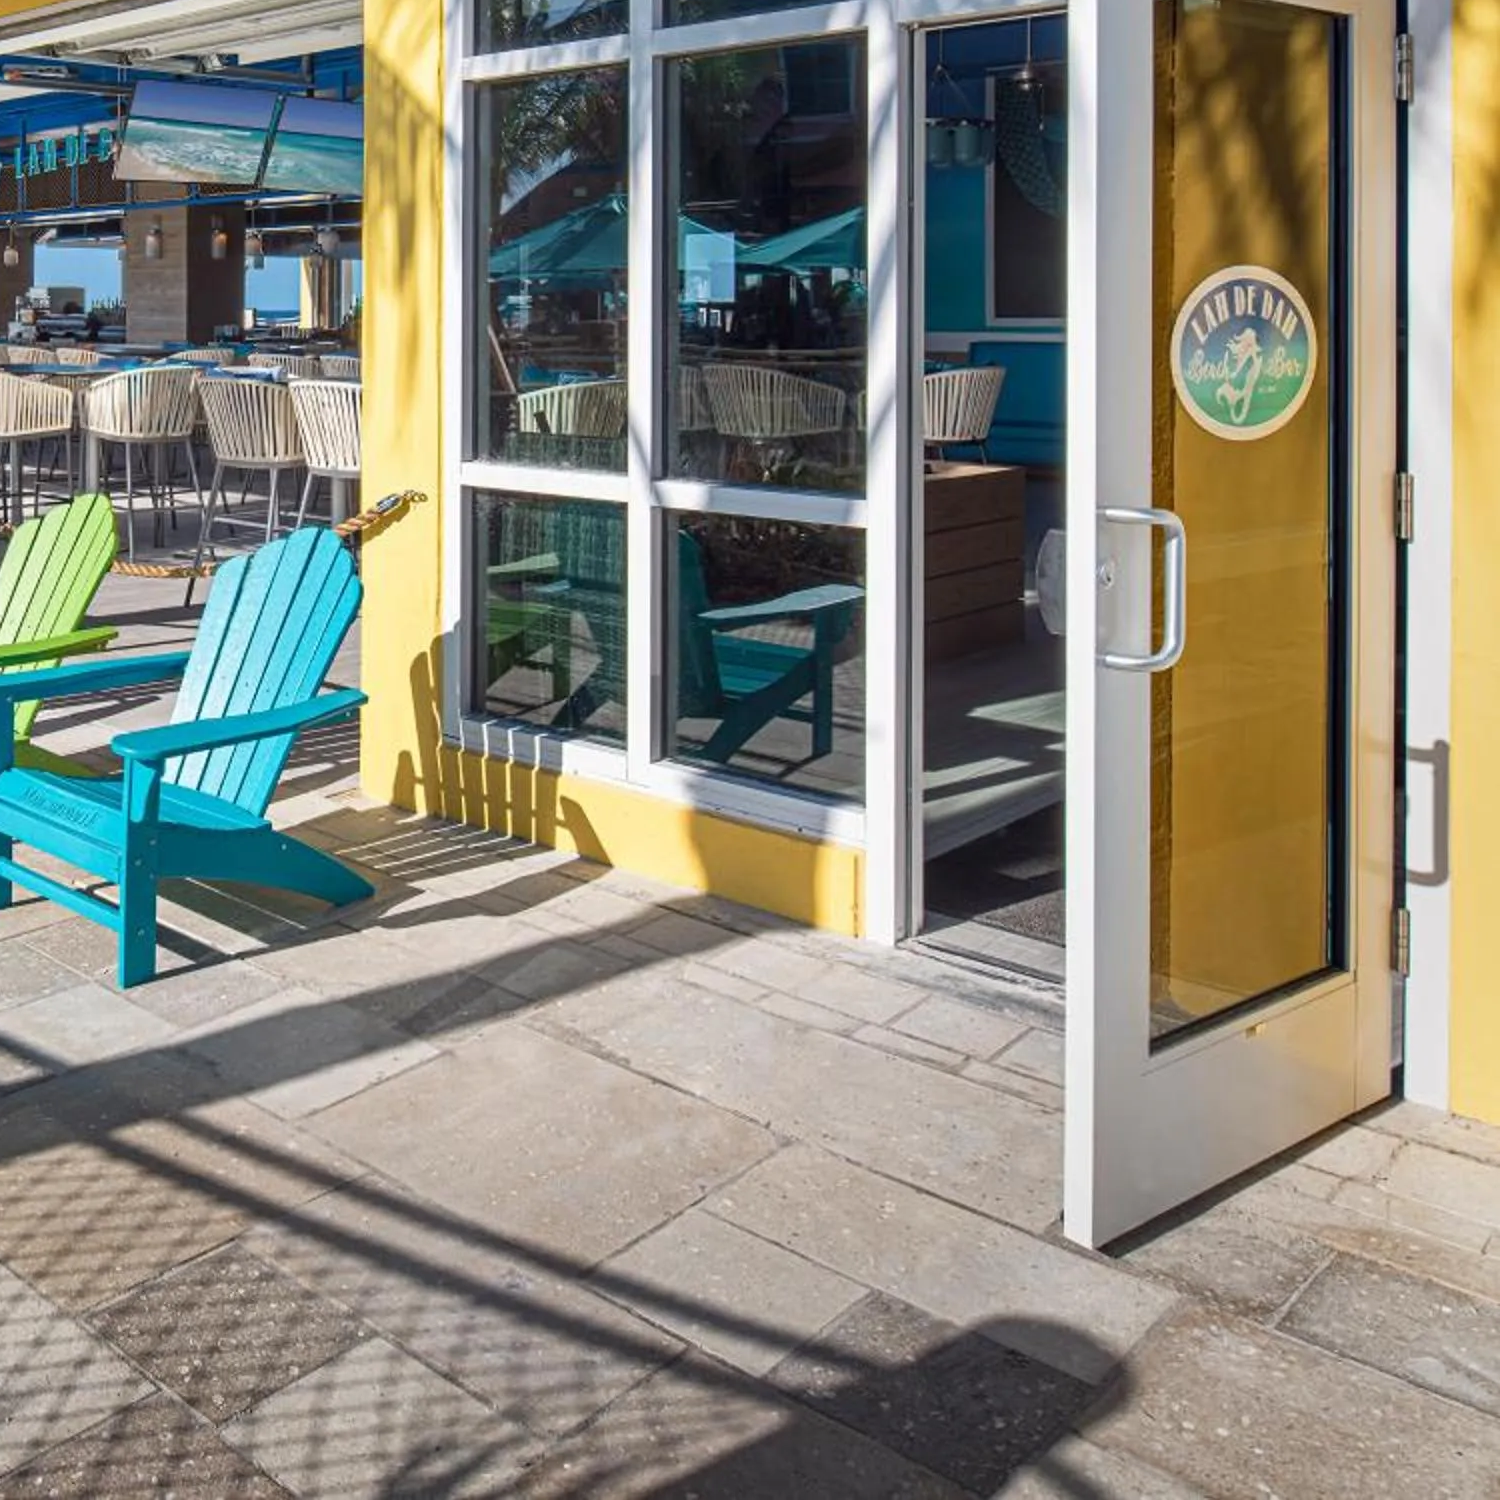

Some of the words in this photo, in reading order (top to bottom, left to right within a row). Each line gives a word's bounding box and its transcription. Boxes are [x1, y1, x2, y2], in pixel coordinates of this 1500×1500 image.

[1190, 290, 1230, 345] LAH
[1233, 285, 1257, 317] DE
[1261, 289, 1299, 341] DAH
